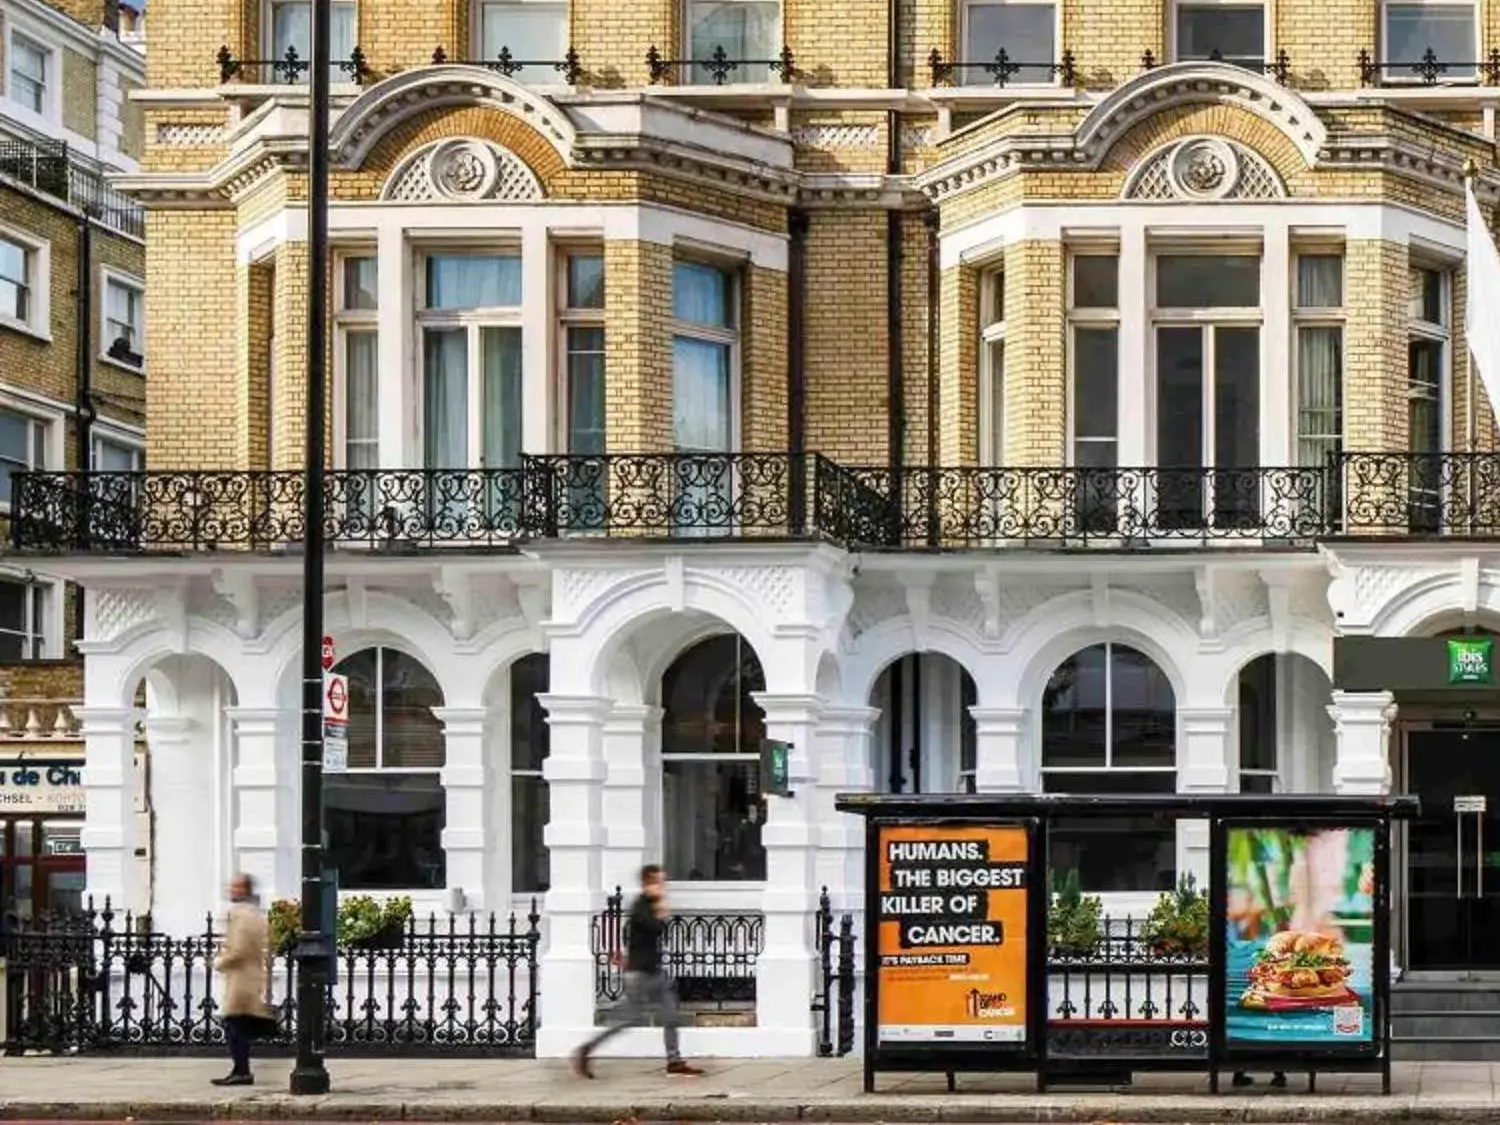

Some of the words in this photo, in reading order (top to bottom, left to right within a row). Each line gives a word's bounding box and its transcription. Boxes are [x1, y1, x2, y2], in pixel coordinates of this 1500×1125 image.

[889, 842, 984, 860] HUMANS.
[895, 869, 931, 888] THE
[936, 868, 1025, 887] BIGGEST
[881, 895, 944, 914] KILLER
[950, 895, 978, 914] OF
[907, 925, 1000, 944] CANCER.
[900, 955, 943, 965] PAYBACK
[945, 954, 967, 964] TIME
